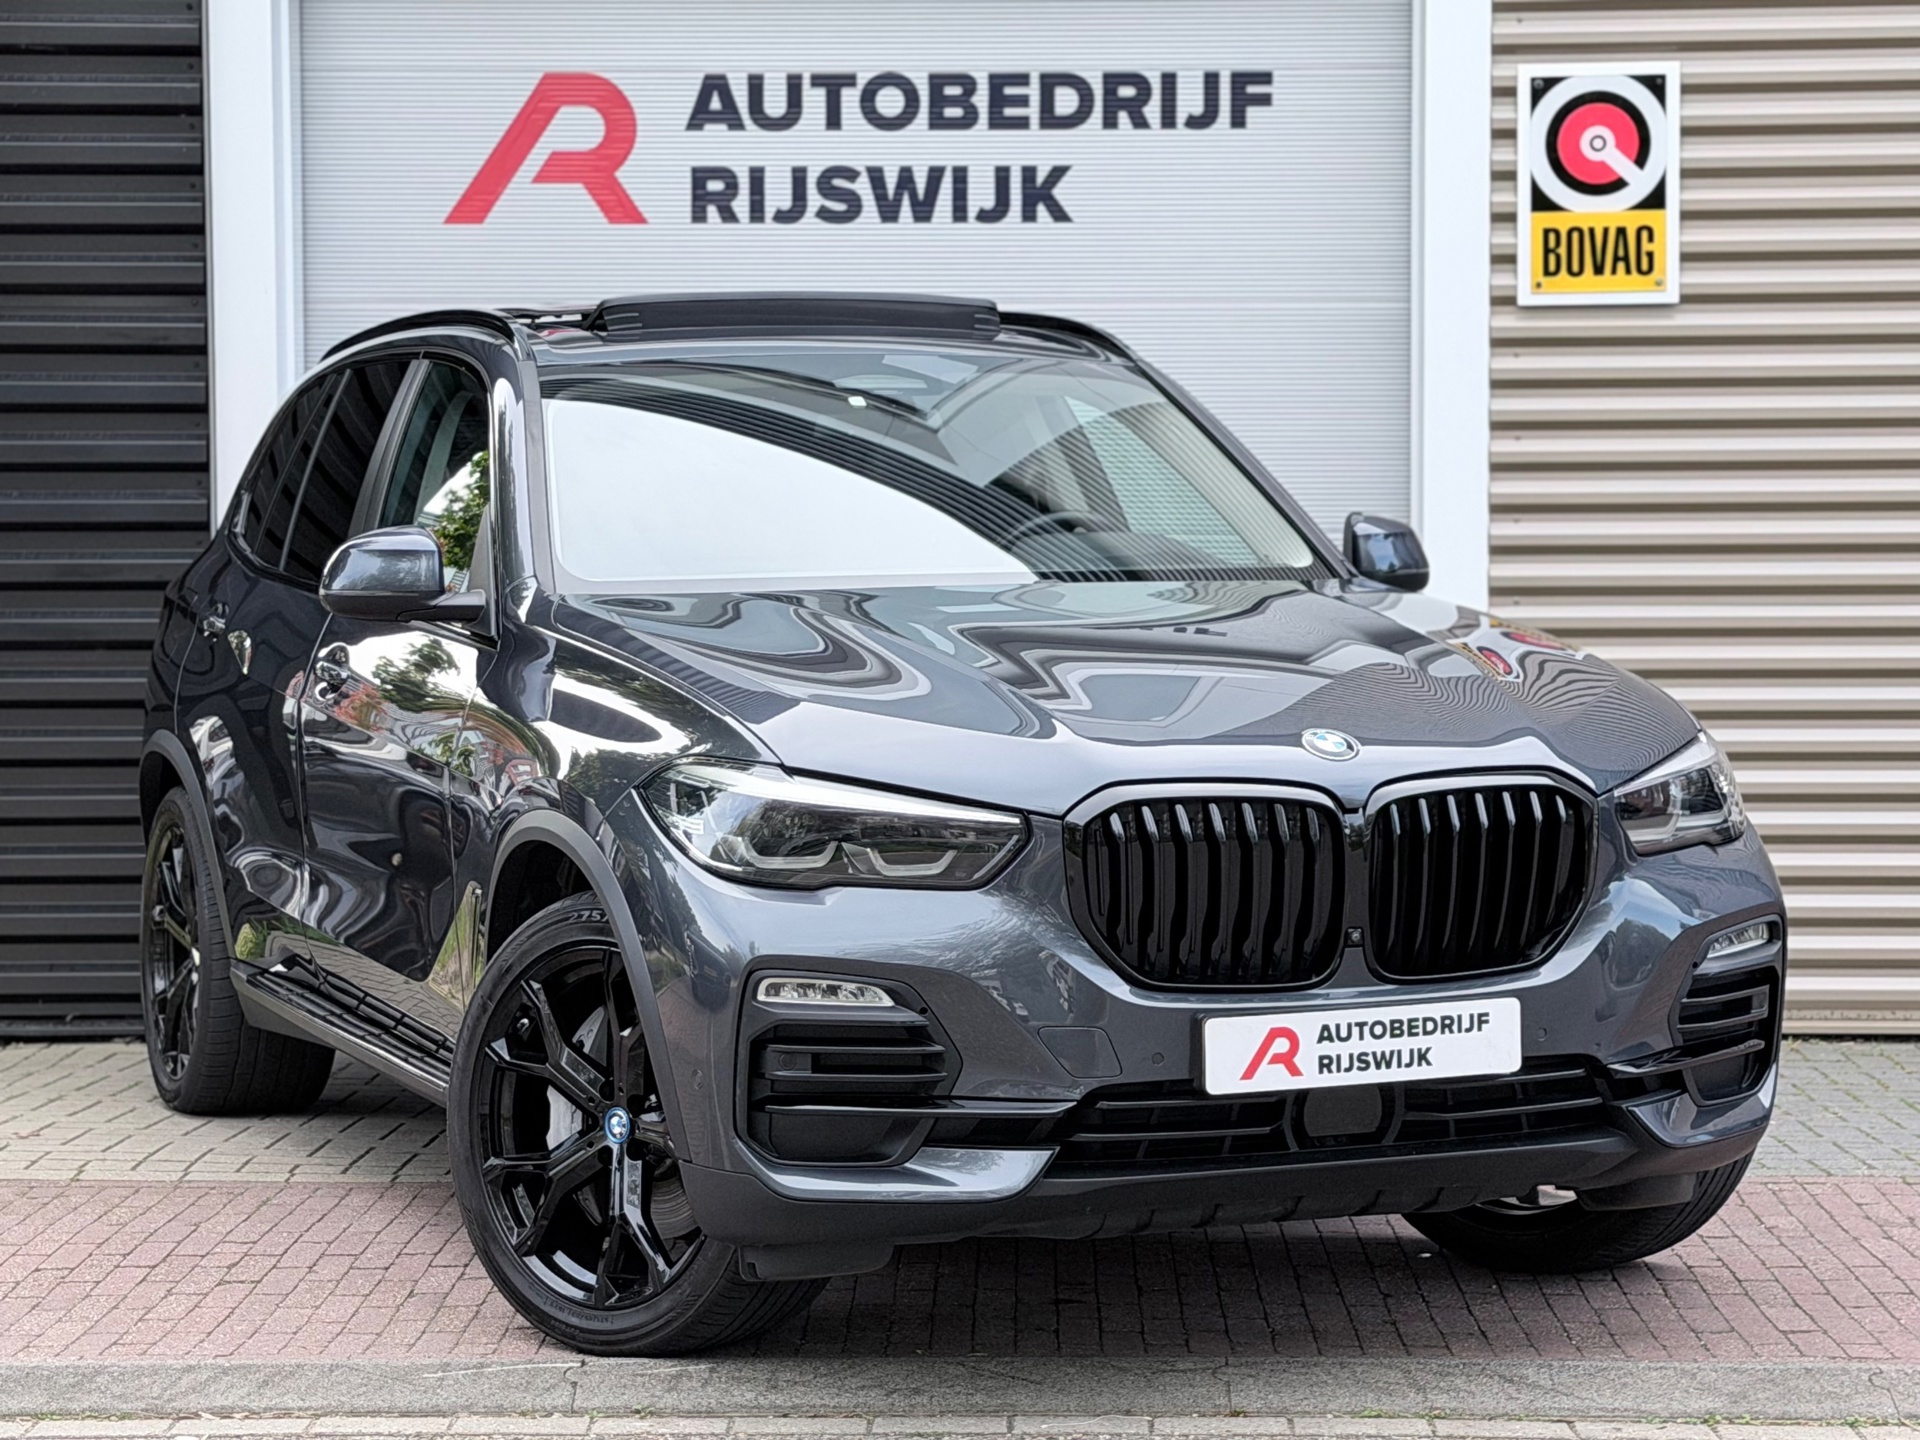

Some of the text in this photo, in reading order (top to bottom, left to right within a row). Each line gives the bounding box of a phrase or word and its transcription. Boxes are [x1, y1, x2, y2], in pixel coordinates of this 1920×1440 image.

[686, 71, 1274, 131] AUTOBEDRIJF
[691, 165, 1073, 224] RIJSWIJK
[1542, 225, 1655, 278] BOVAG
[1316, 1012, 1490, 1044] AUTOBEDRIJF
[1318, 1047, 1433, 1075] RIJSWIJK
